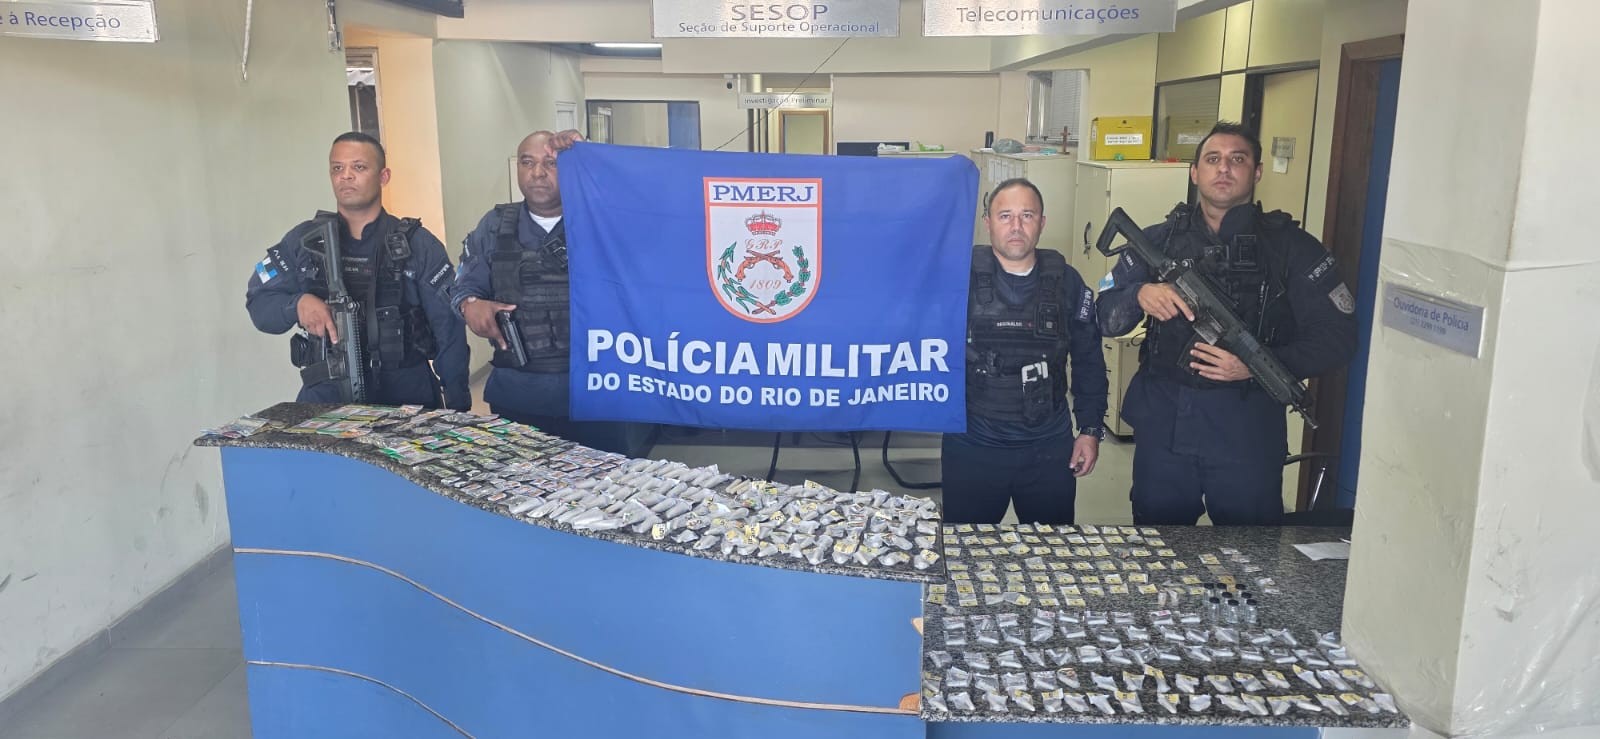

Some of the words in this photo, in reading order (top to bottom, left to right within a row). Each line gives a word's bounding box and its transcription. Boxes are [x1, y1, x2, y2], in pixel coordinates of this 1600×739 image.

[9, 11, 18, 25] à
[25, 11, 121, 31] Recepção
[731, 4, 829, 21] SESOP
[956, 6, 1140, 24] Telecomunicações
[679, 22, 716, 34] Seção
[721, 22, 737, 32] de
[741, 22, 795, 34] Suporte
[799, 22, 879, 34] Operacional
[712, 184, 815, 203] PMERJ
[750, 279, 782, 290] 1809
[1393, 296, 1429, 319] Ouvidoria
[1430, 309, 1441, 322] de
[587, 329, 760, 375] POLÍCIA
[767, 338, 950, 377] MILITAR
[587, 372, 621, 391] DO
[628, 373, 712, 403] ESTADO
[720, 385, 753, 405] DO
[761, 387, 801, 406] RIO
[809, 388, 840, 407] DE
[847, 382, 950, 405] JANEIRO
